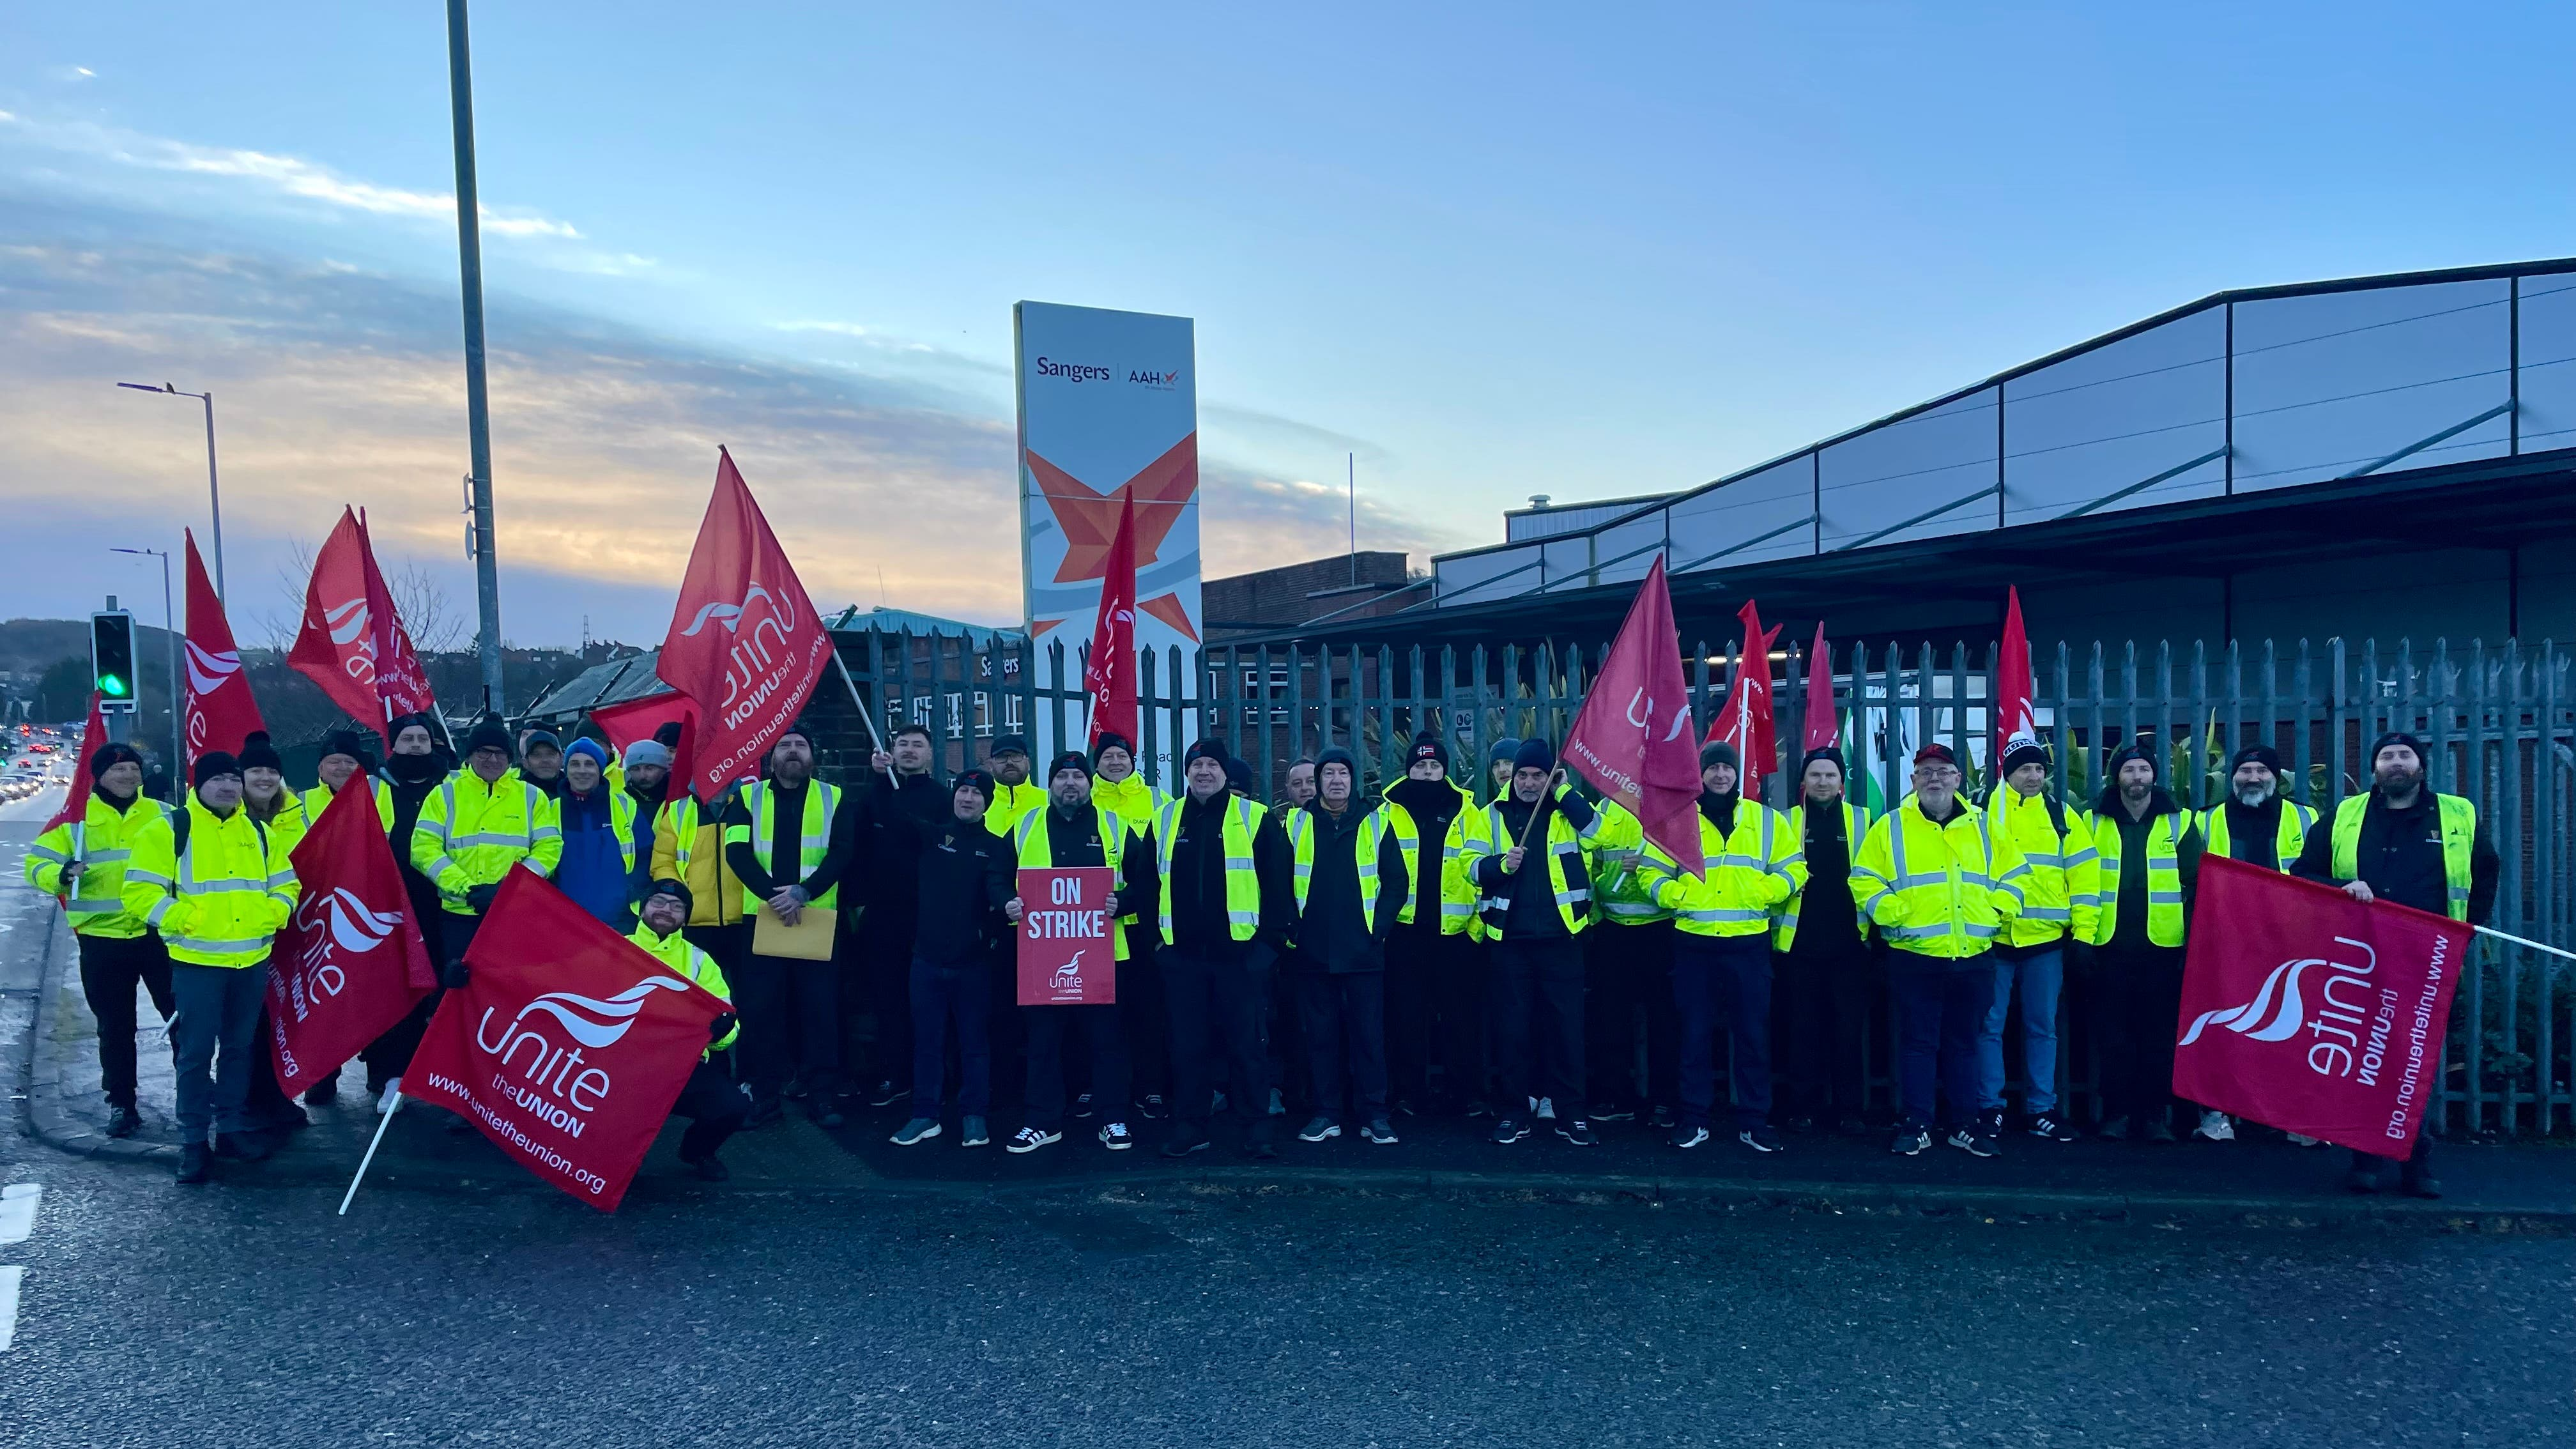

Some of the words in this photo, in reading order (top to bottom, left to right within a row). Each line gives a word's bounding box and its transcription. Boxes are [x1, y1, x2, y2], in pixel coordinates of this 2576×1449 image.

[1037, 356, 1110, 383] Sangers
[1129, 371, 1160, 385] AAH
[1051, 877, 1081, 905] ON
[1027, 910, 1105, 939] STRIKE
[1049, 976, 1082, 988] unite
[477, 1006, 610, 1112] unite
[492, 1073, 586, 1139] theUNION
[428, 1072, 607, 1195] www.unitetheunion.org
